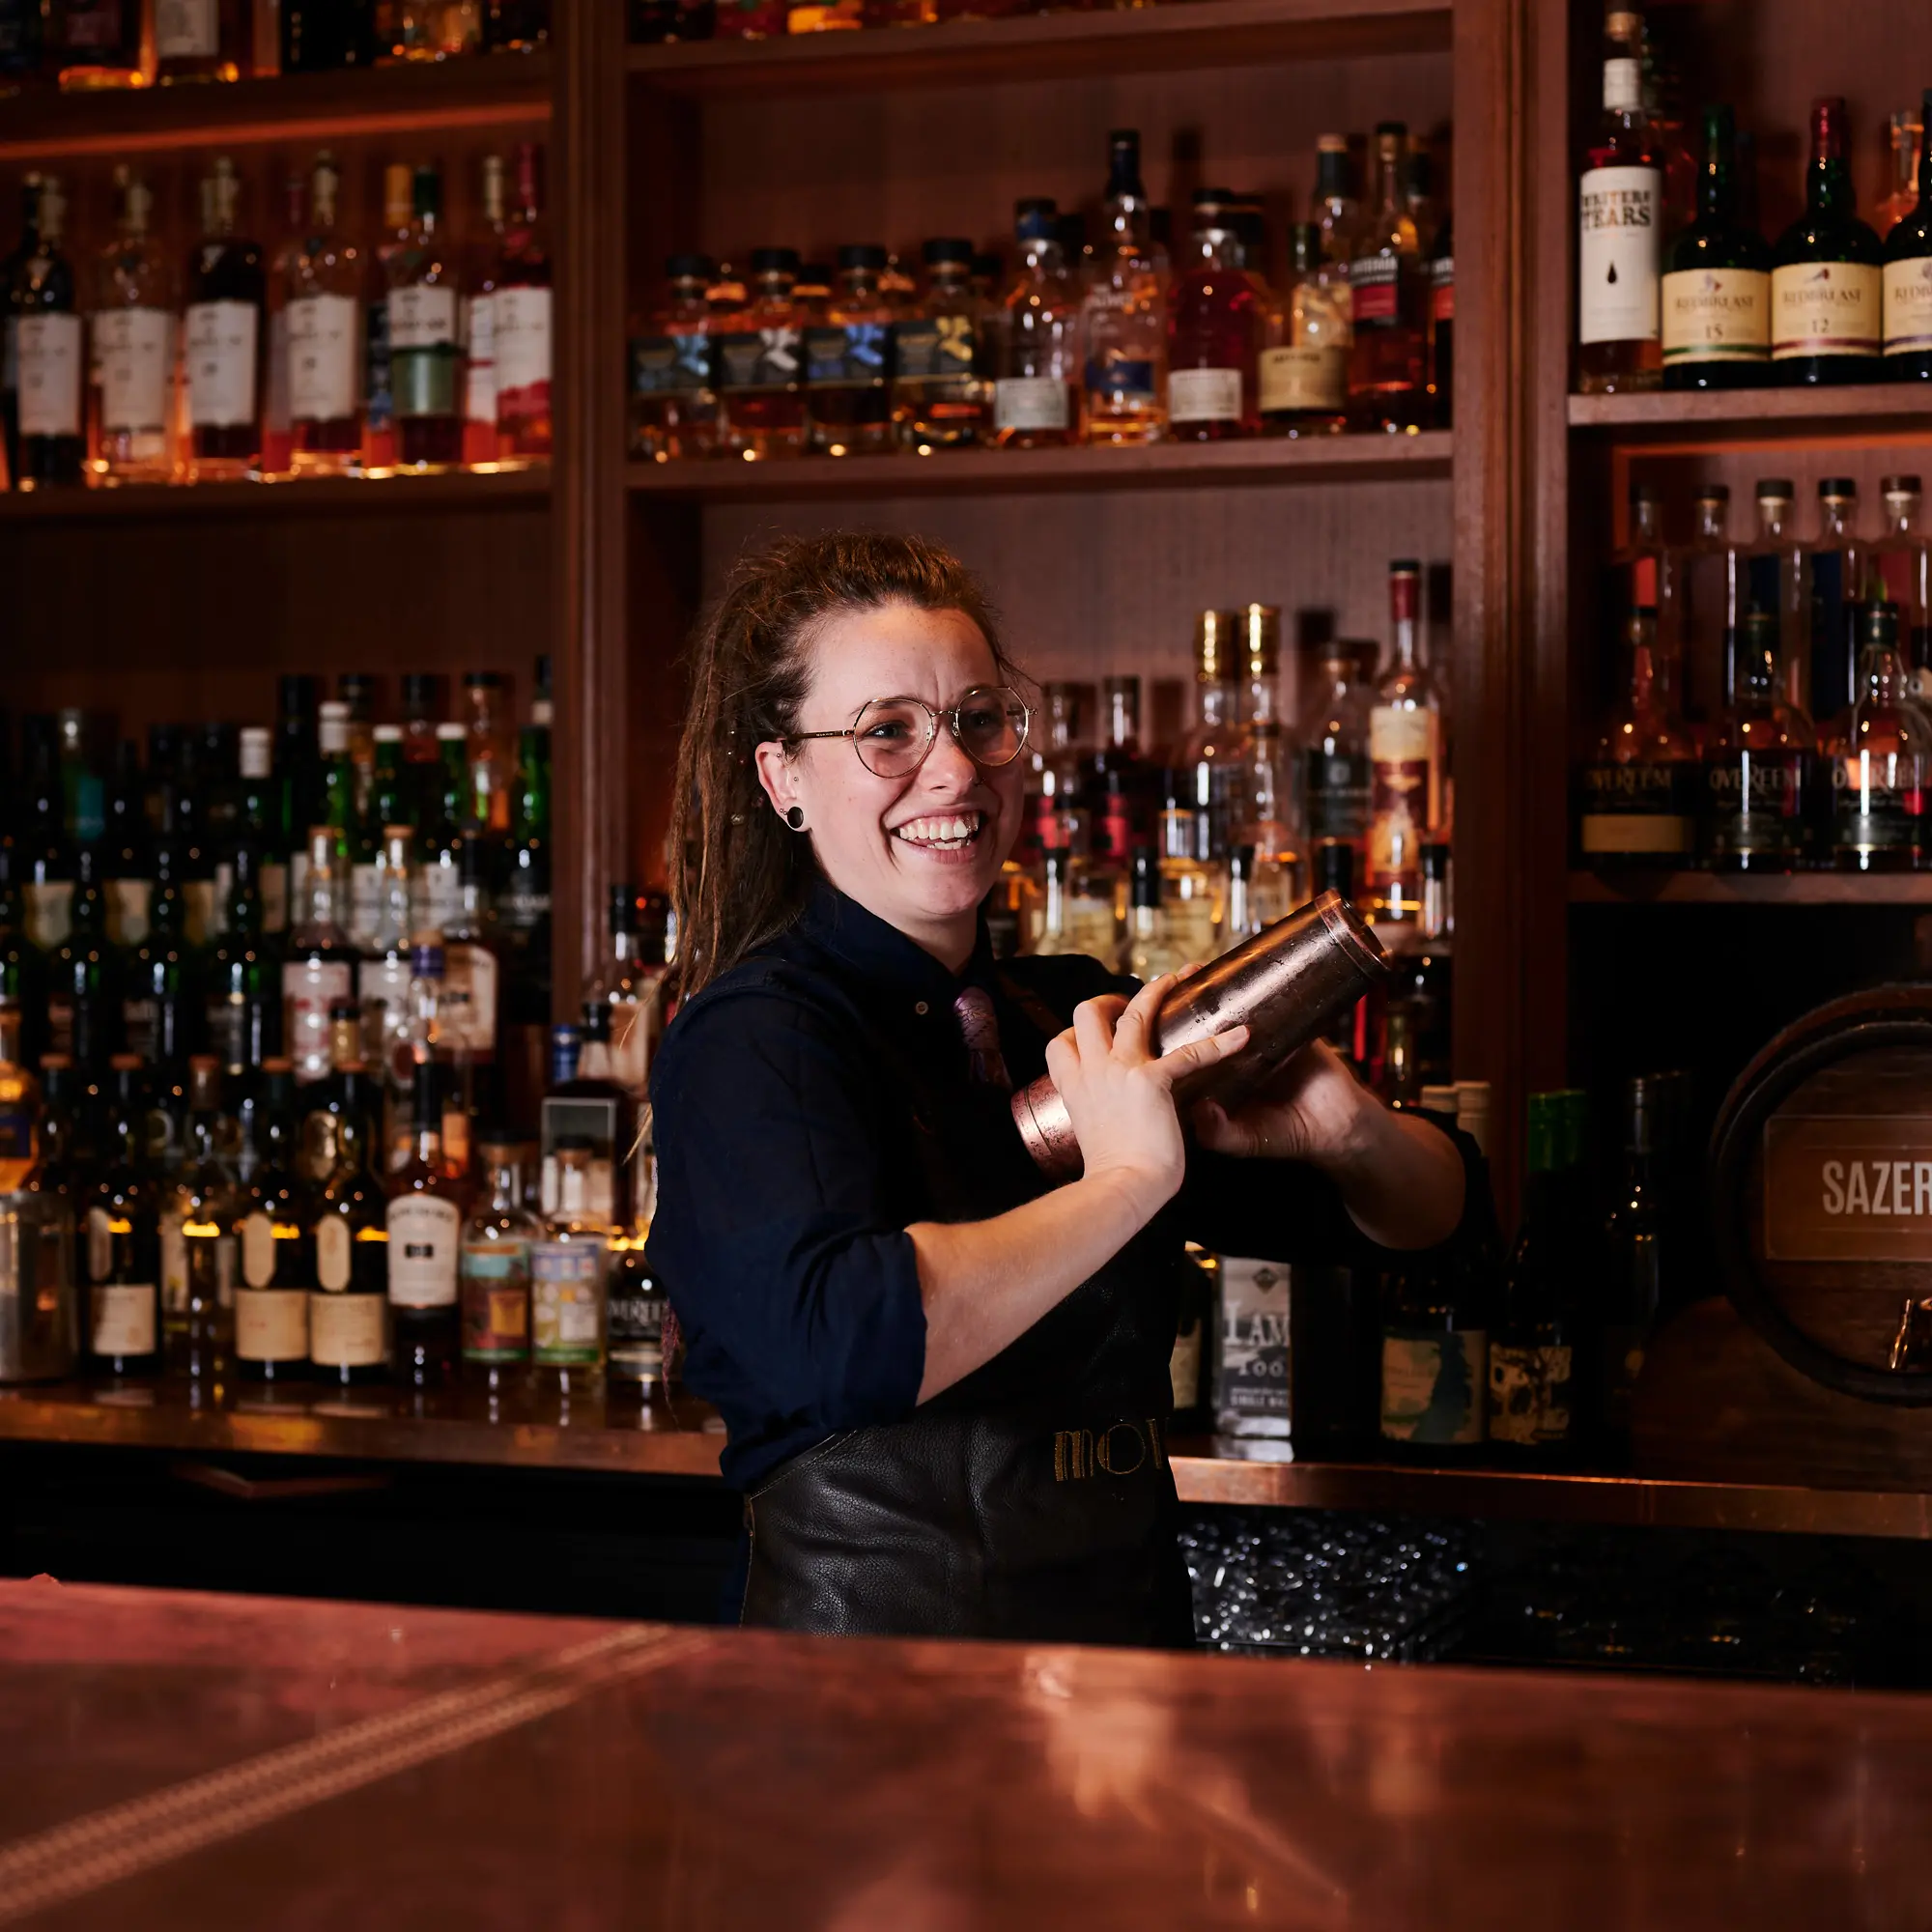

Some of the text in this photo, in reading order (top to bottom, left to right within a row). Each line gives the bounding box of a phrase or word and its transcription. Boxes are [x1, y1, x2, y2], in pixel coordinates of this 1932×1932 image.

[1581, 205, 1651, 231] TEARS
[1705, 324, 1722, 340] 15
[1811, 318, 1829, 334] 12
[1822, 1159, 1932, 1216] SAZER
